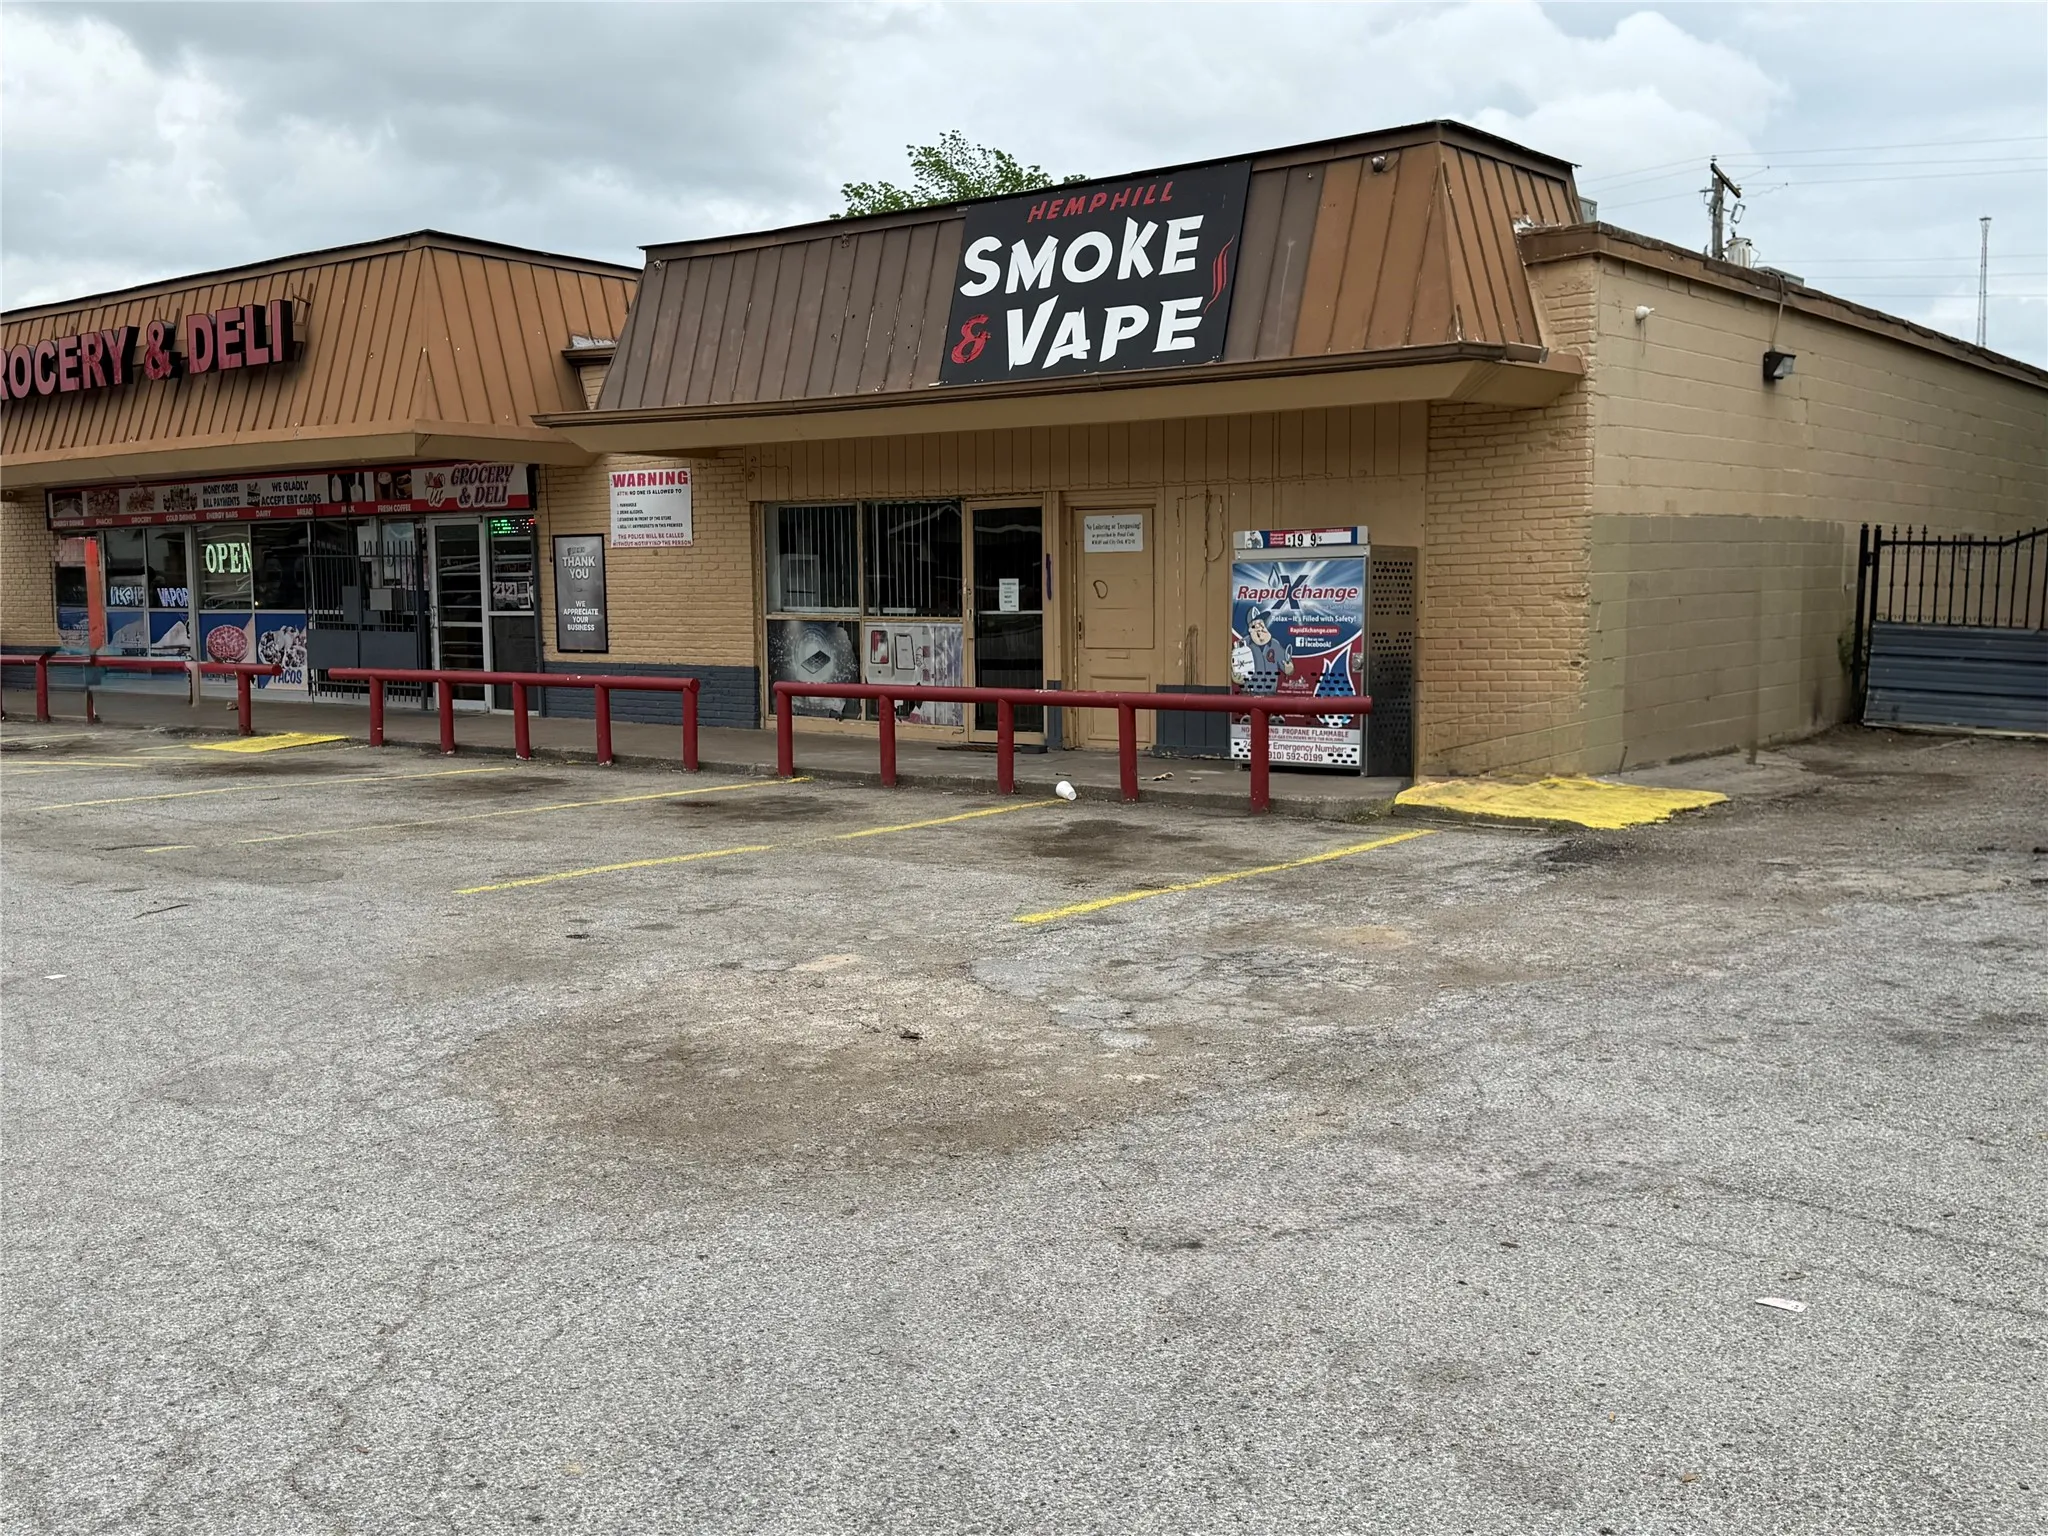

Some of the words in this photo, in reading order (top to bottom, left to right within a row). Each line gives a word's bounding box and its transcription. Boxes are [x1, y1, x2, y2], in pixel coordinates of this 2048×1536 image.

[1027, 181, 1174, 223] HEMPHILL
[960, 214, 1204, 297] SMOKE
[951, 314, 992, 364] &
[1006, 295, 1204, 372] VAPE
[144, 320, 174, 381] &
[186, 299, 283, 375] DELI
[451, 464, 515, 486] GROCERY
[612, 470, 688, 488] WARNING
[203, 484, 220, 495] MONEY
[221, 483, 238, 493] ORDER
[272, 482, 282, 492] WE
[283, 480, 309, 491] GLADLY
[261, 495, 285, 506] ACCEPT
[286, 494, 298, 505] EBT
[299, 493, 321, 504] CARDS
[459, 486, 471, 504] &
[473, 485, 508, 504] DELI
[203, 498, 213, 508] BILL
[214, 496, 240, 507] PAYMENTS
[377, 504, 393, 512] FRESH
[394, 503, 412, 512] COFFEE
[205, 542, 251, 574] OPEN
[562, 556, 596, 567] THANK
[570, 568, 589, 579] YOU
[1334, 615, 1356, 624] Safety!
[1282, 728, 1310, 737] PROPANE
[1312, 730, 1349, 738] FLAMMABLE
[1273, 742, 1313, 753] Emergency
[1315, 745, 1347, 754] Number:
[1286, 753, 1323, 762] 592-0199
